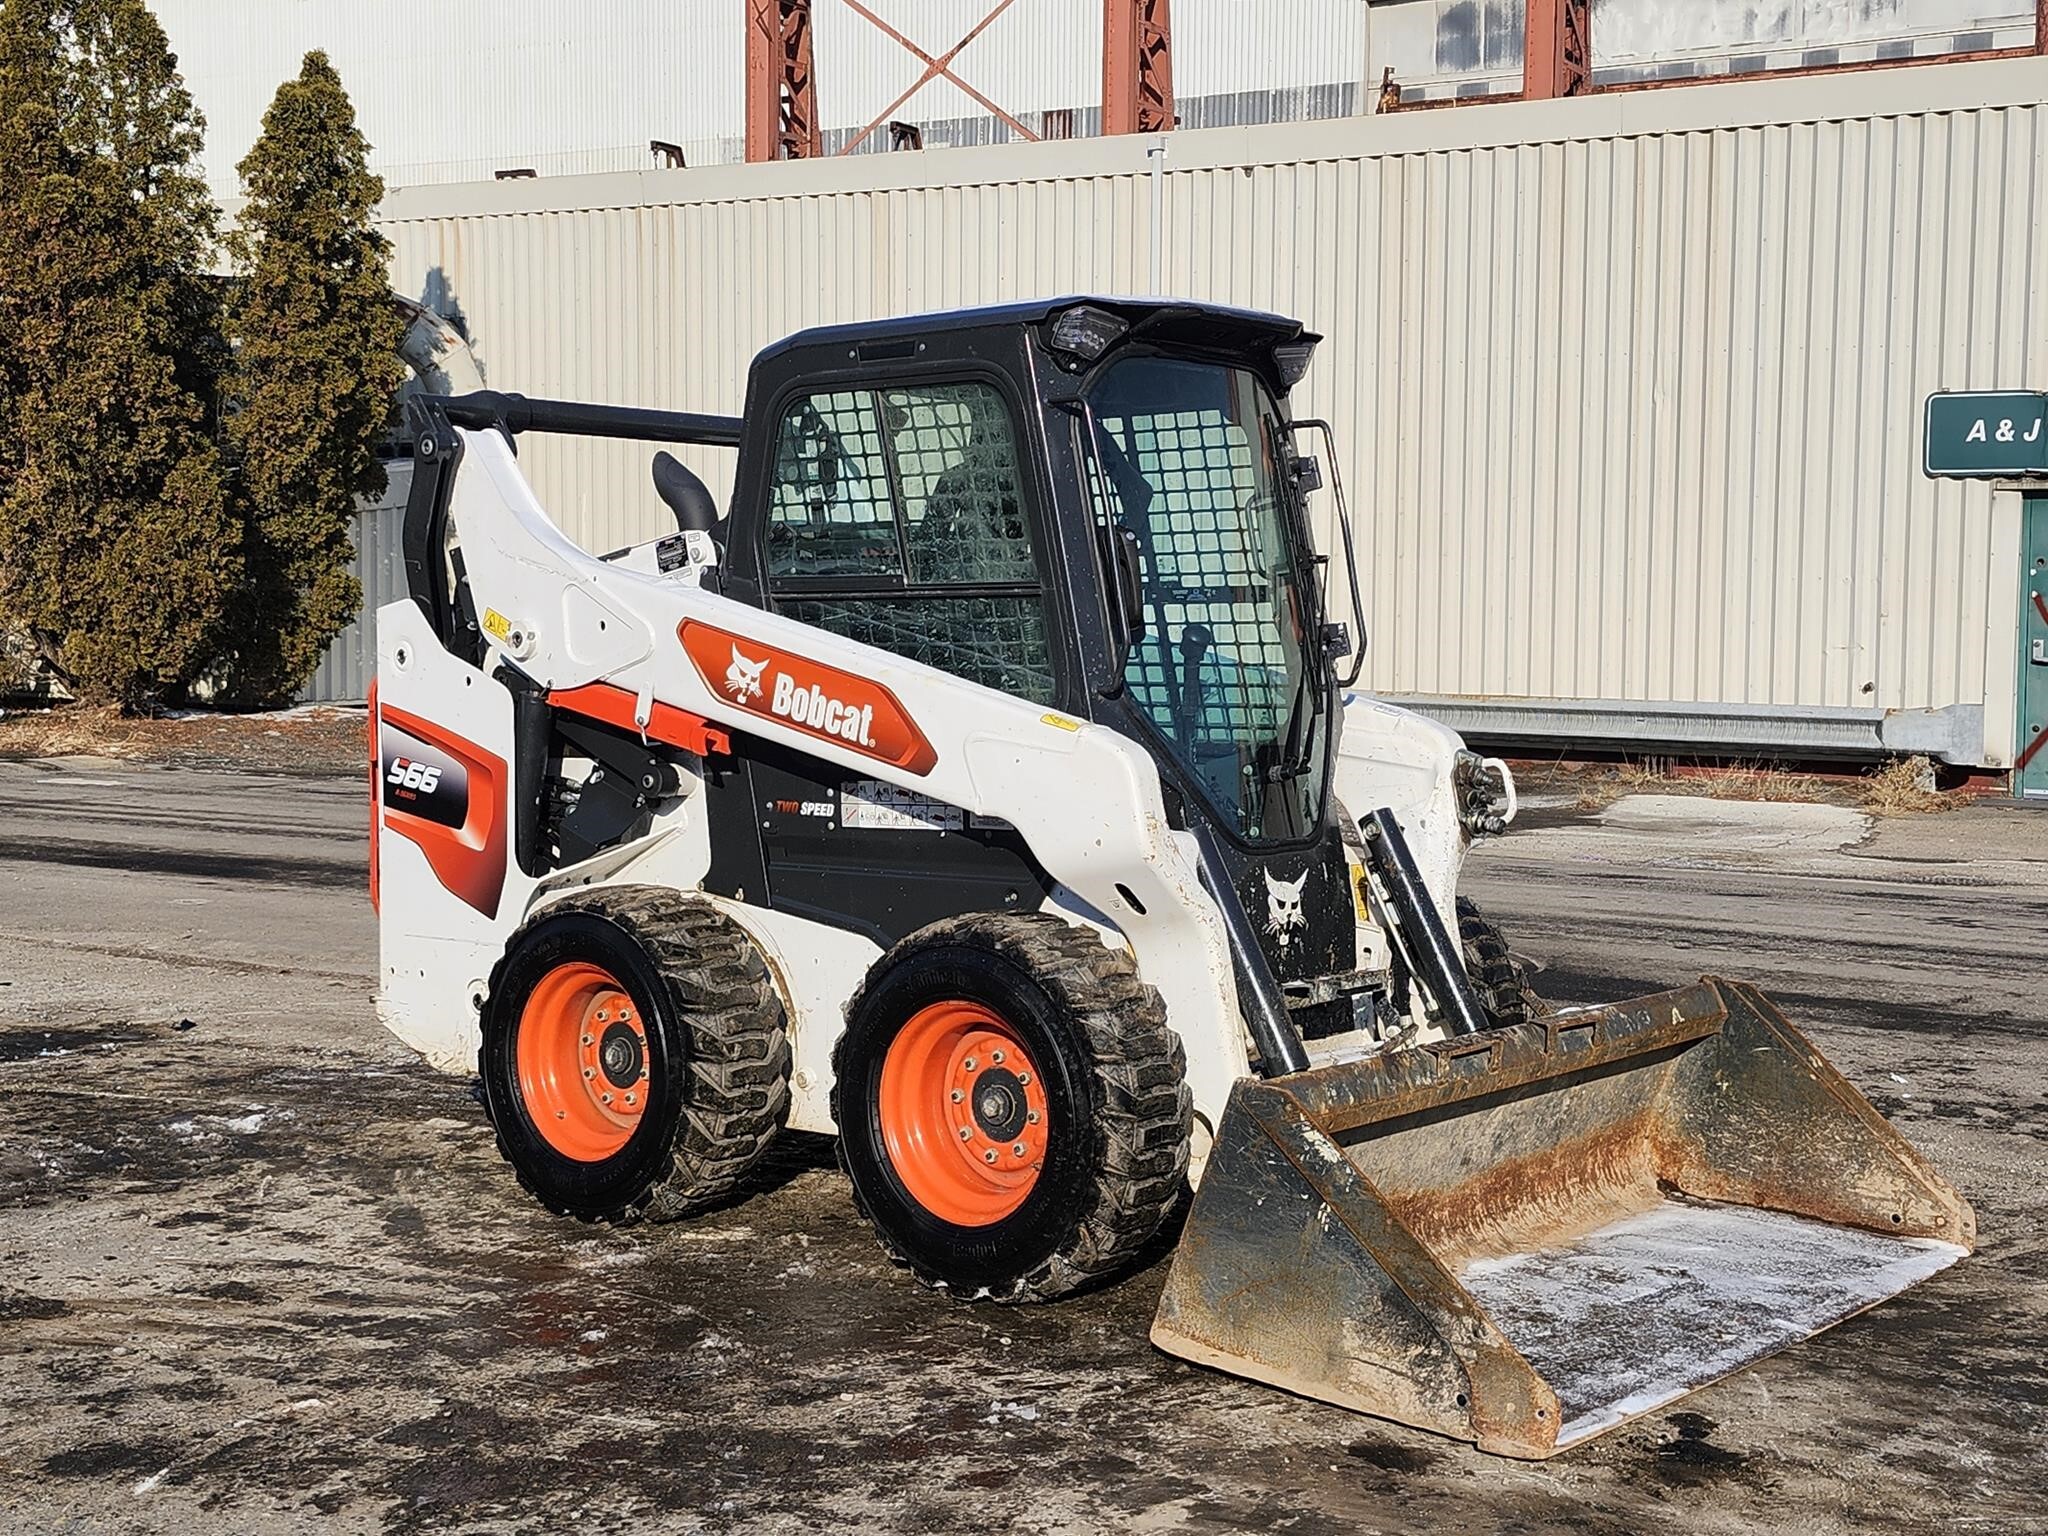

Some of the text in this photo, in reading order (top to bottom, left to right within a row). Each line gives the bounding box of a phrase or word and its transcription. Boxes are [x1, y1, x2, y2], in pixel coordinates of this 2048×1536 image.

[1965, 418, 2042, 442] A & J
[771, 671, 873, 747] Bobcat
[386, 757, 443, 794] S66
[776, 800, 835, 817] TWO SPEED
